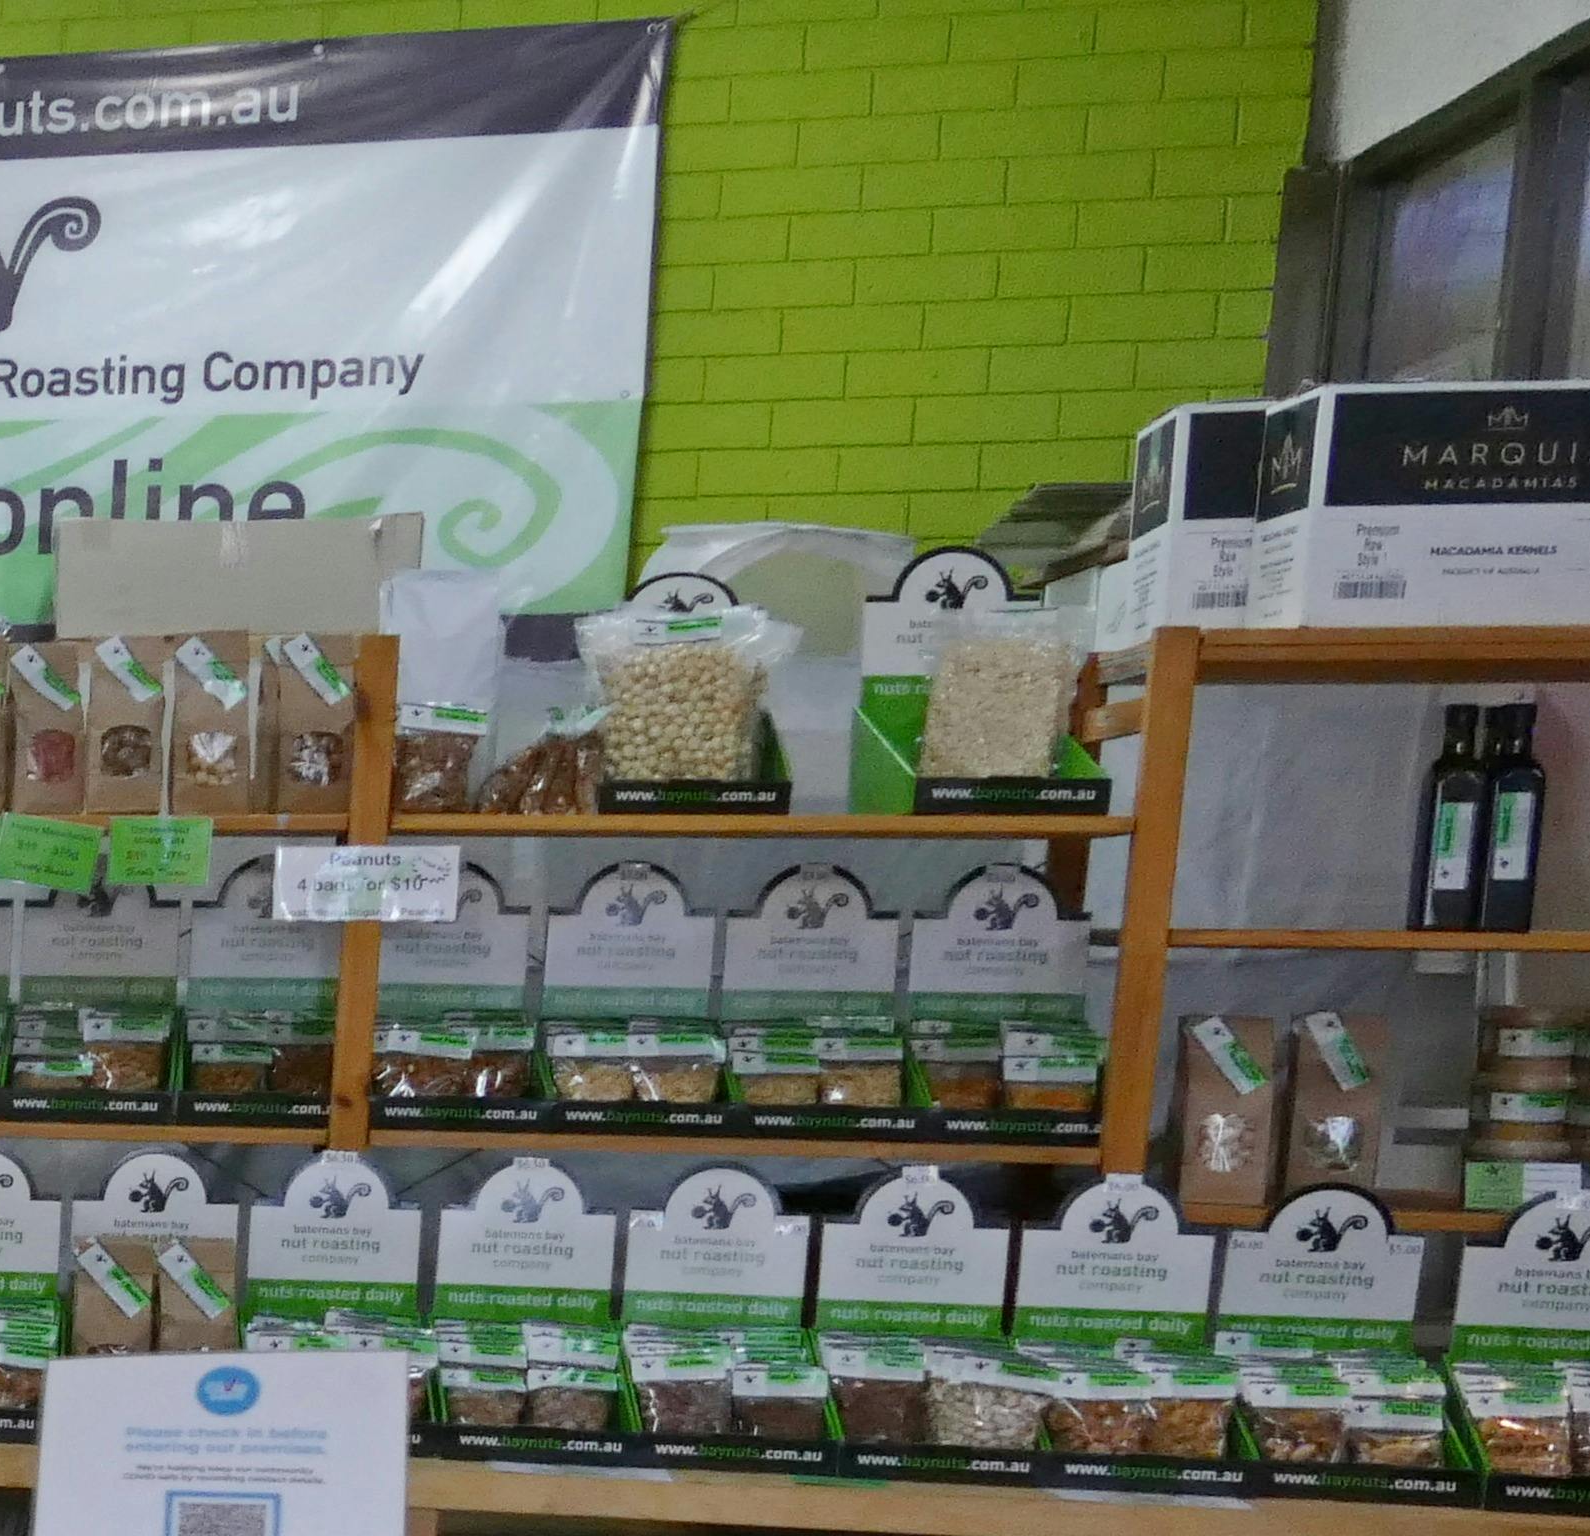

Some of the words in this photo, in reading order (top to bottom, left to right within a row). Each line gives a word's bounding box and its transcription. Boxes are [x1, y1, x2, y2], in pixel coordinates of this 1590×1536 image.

[202, 346, 423, 394] Company
[1401, 439, 1590, 468] MARQUI
[1423, 476, 1579, 491] MACADAMIAS
[1429, 545, 1503, 556] MACADAMIA
[1506, 544, 1558, 556] KERNELS
[615, 788, 777, 804] www.baynuts.com.au
[329, 852, 402, 867] Peanuts
[296, 878, 308, 891] 4
[391, 877, 423, 891] $10
[280, 1238, 308, 1250] nut
[311, 1239, 381, 1255] roasting
[471, 1243, 499, 1255] nut
[503, 1243, 575, 1260] roasting
[1056, 1263, 1086, 1276] nut
[1091, 1264, 1169, 1282] roasting
[1259, 1272, 1291, 1284] nut
[1296, 1272, 1375, 1290] roasting
[556, 1294, 598, 1310] daily
[1147, 1317, 1192, 1335] daily
[459, 1431, 624, 1453] www.baynuts.com.au
[654, 1441, 823, 1462] www.baynuts.com.au
[857, 1452, 1031, 1475] www.baynuts.com.au
[1064, 1460, 1244, 1484] www.baynuts.com.au
[1274, 1471, 1457, 1493] www.baynuts.com.au
